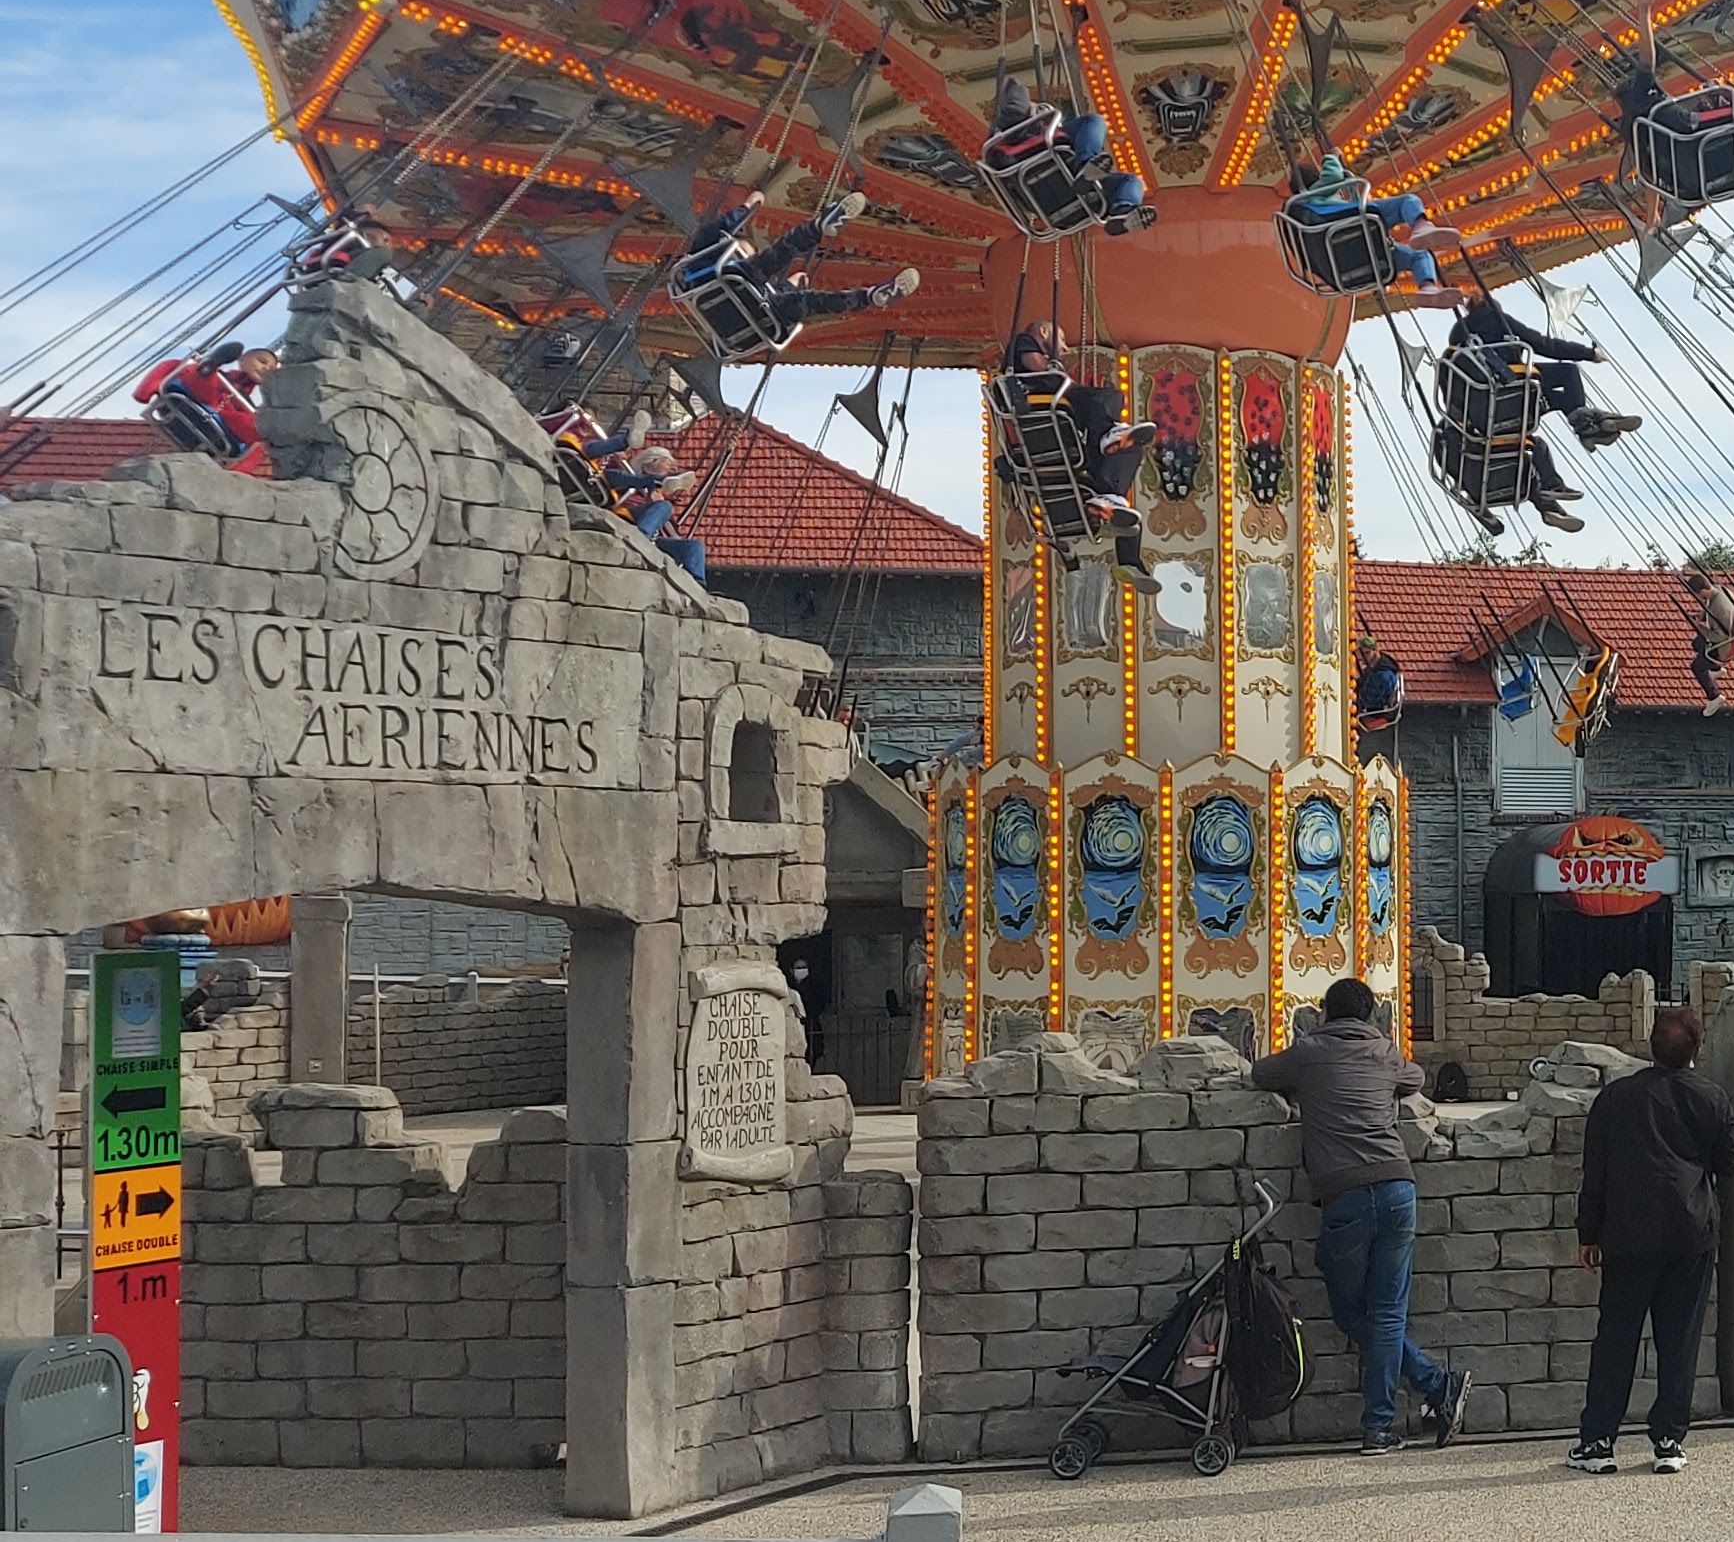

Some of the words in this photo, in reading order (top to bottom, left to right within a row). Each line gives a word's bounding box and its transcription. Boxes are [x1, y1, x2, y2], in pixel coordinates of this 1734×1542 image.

[97, 607, 224, 685] LES
[252, 623, 498, 702] CHAISES
[1558, 859, 1648, 885] SORTIE
[709, 992, 762, 1018] CHAISE
[707, 1015, 770, 1042] DOUBLE
[718, 1038, 759, 1062] POUR
[96, 1061, 136, 1076] CHAISE
[139, 1057, 179, 1073] SIMPLE
[697, 1060, 753, 1086] ENFANT
[755, 1058, 775, 1080] DE
[690, 1101, 775, 1131] ACCOMPAGNE
[97, 1124, 179, 1162] 1.30m
[700, 1129, 723, 1151] PAR
[95, 1240, 135, 1257] CHAISE
[136, 1233, 178, 1251] DOUBLE
